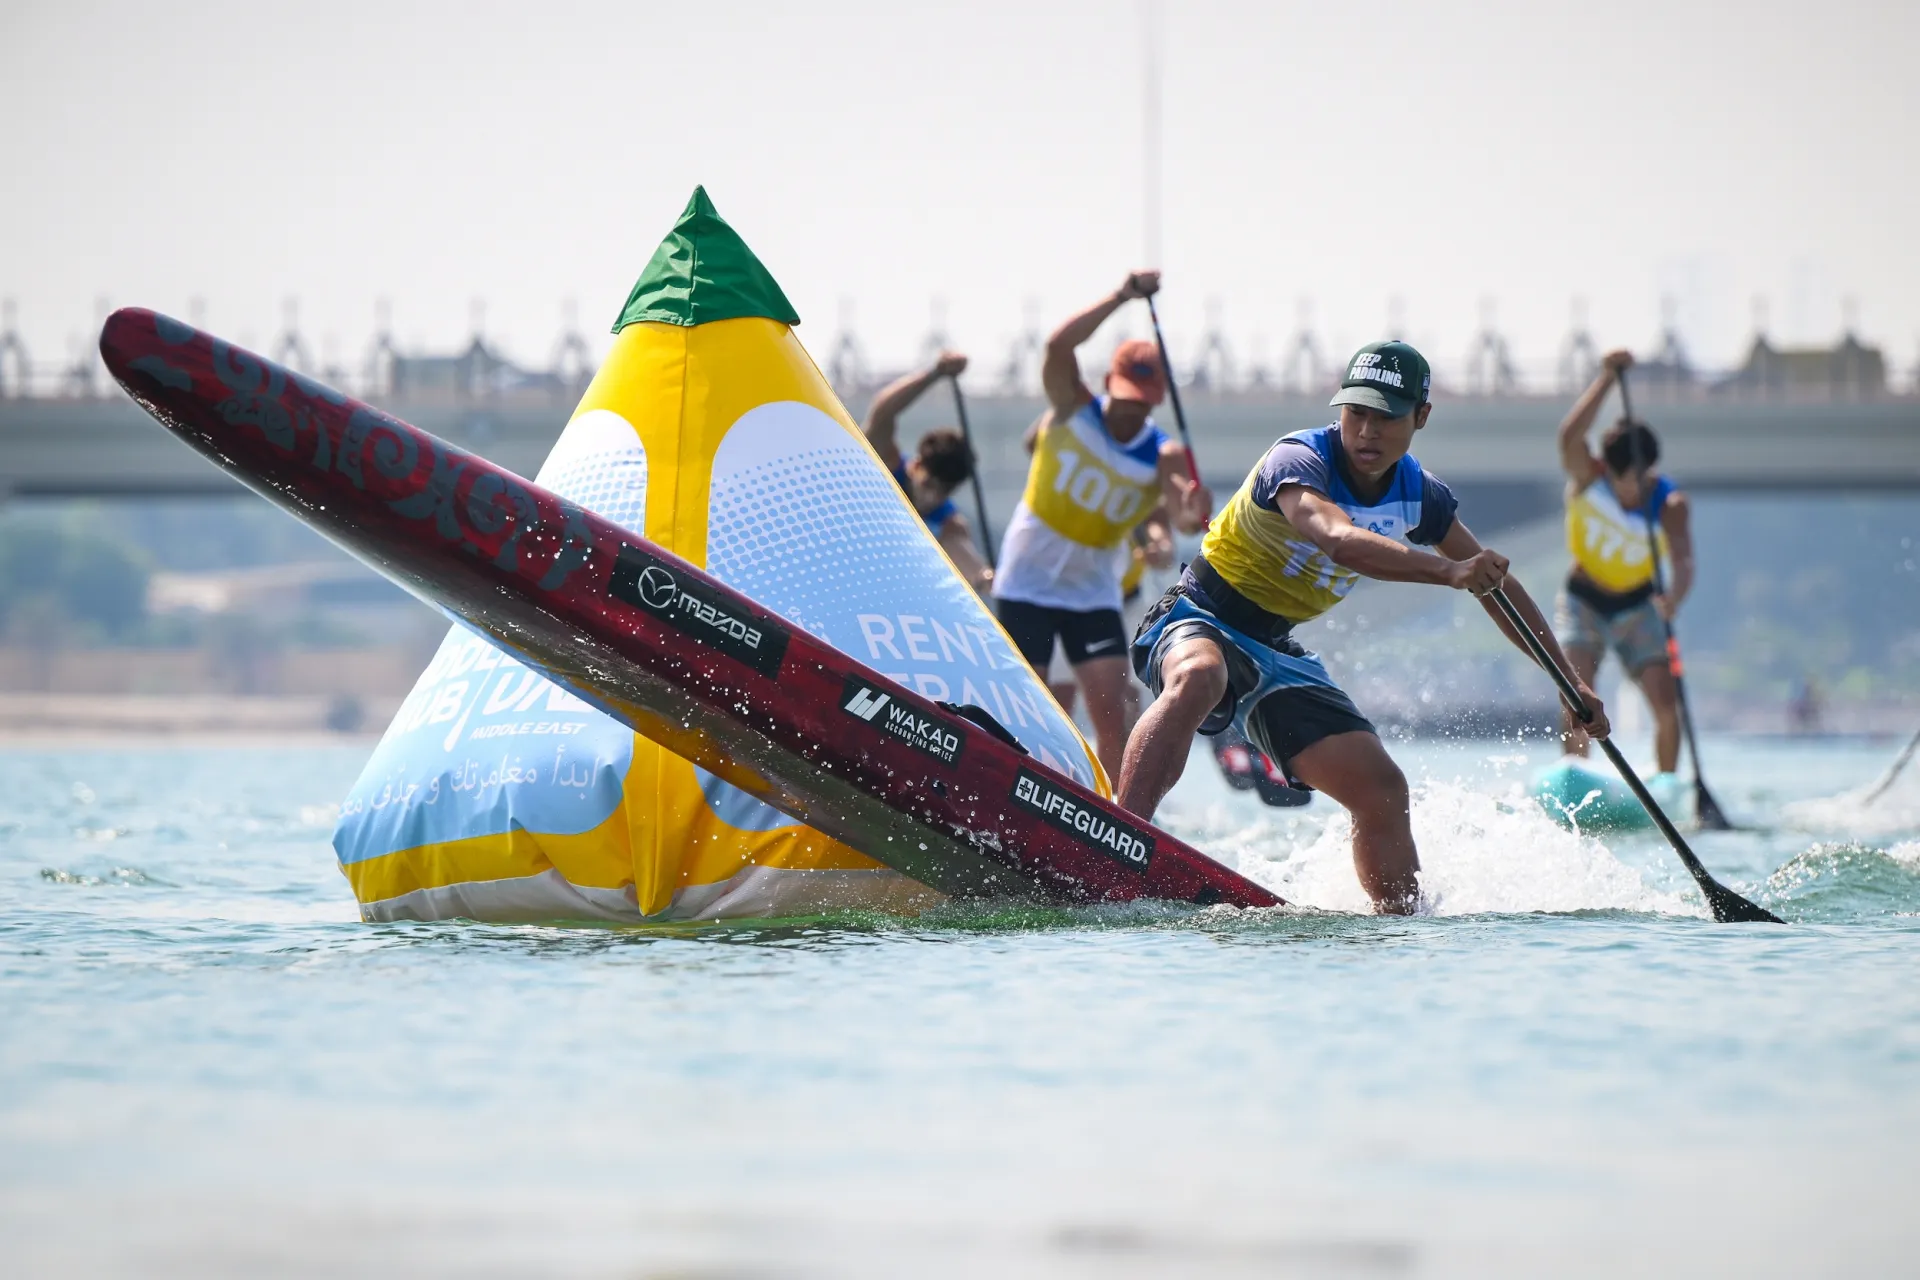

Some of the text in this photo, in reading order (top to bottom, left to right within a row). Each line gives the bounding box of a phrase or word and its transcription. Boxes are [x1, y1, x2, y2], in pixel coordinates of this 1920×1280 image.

[1354, 353, 1382, 367] KEEP
[1054, 450, 1142, 523] 100
[857, 613, 998, 670] RENT
[469, 722, 588, 740] MIDDLE EAST
[885, 721, 927, 749] ACCOUNTING
[889, 704, 959, 753] WAKAO
[451, 752, 537, 800] مغامرتك
[551, 744, 600, 801] ابدأ
